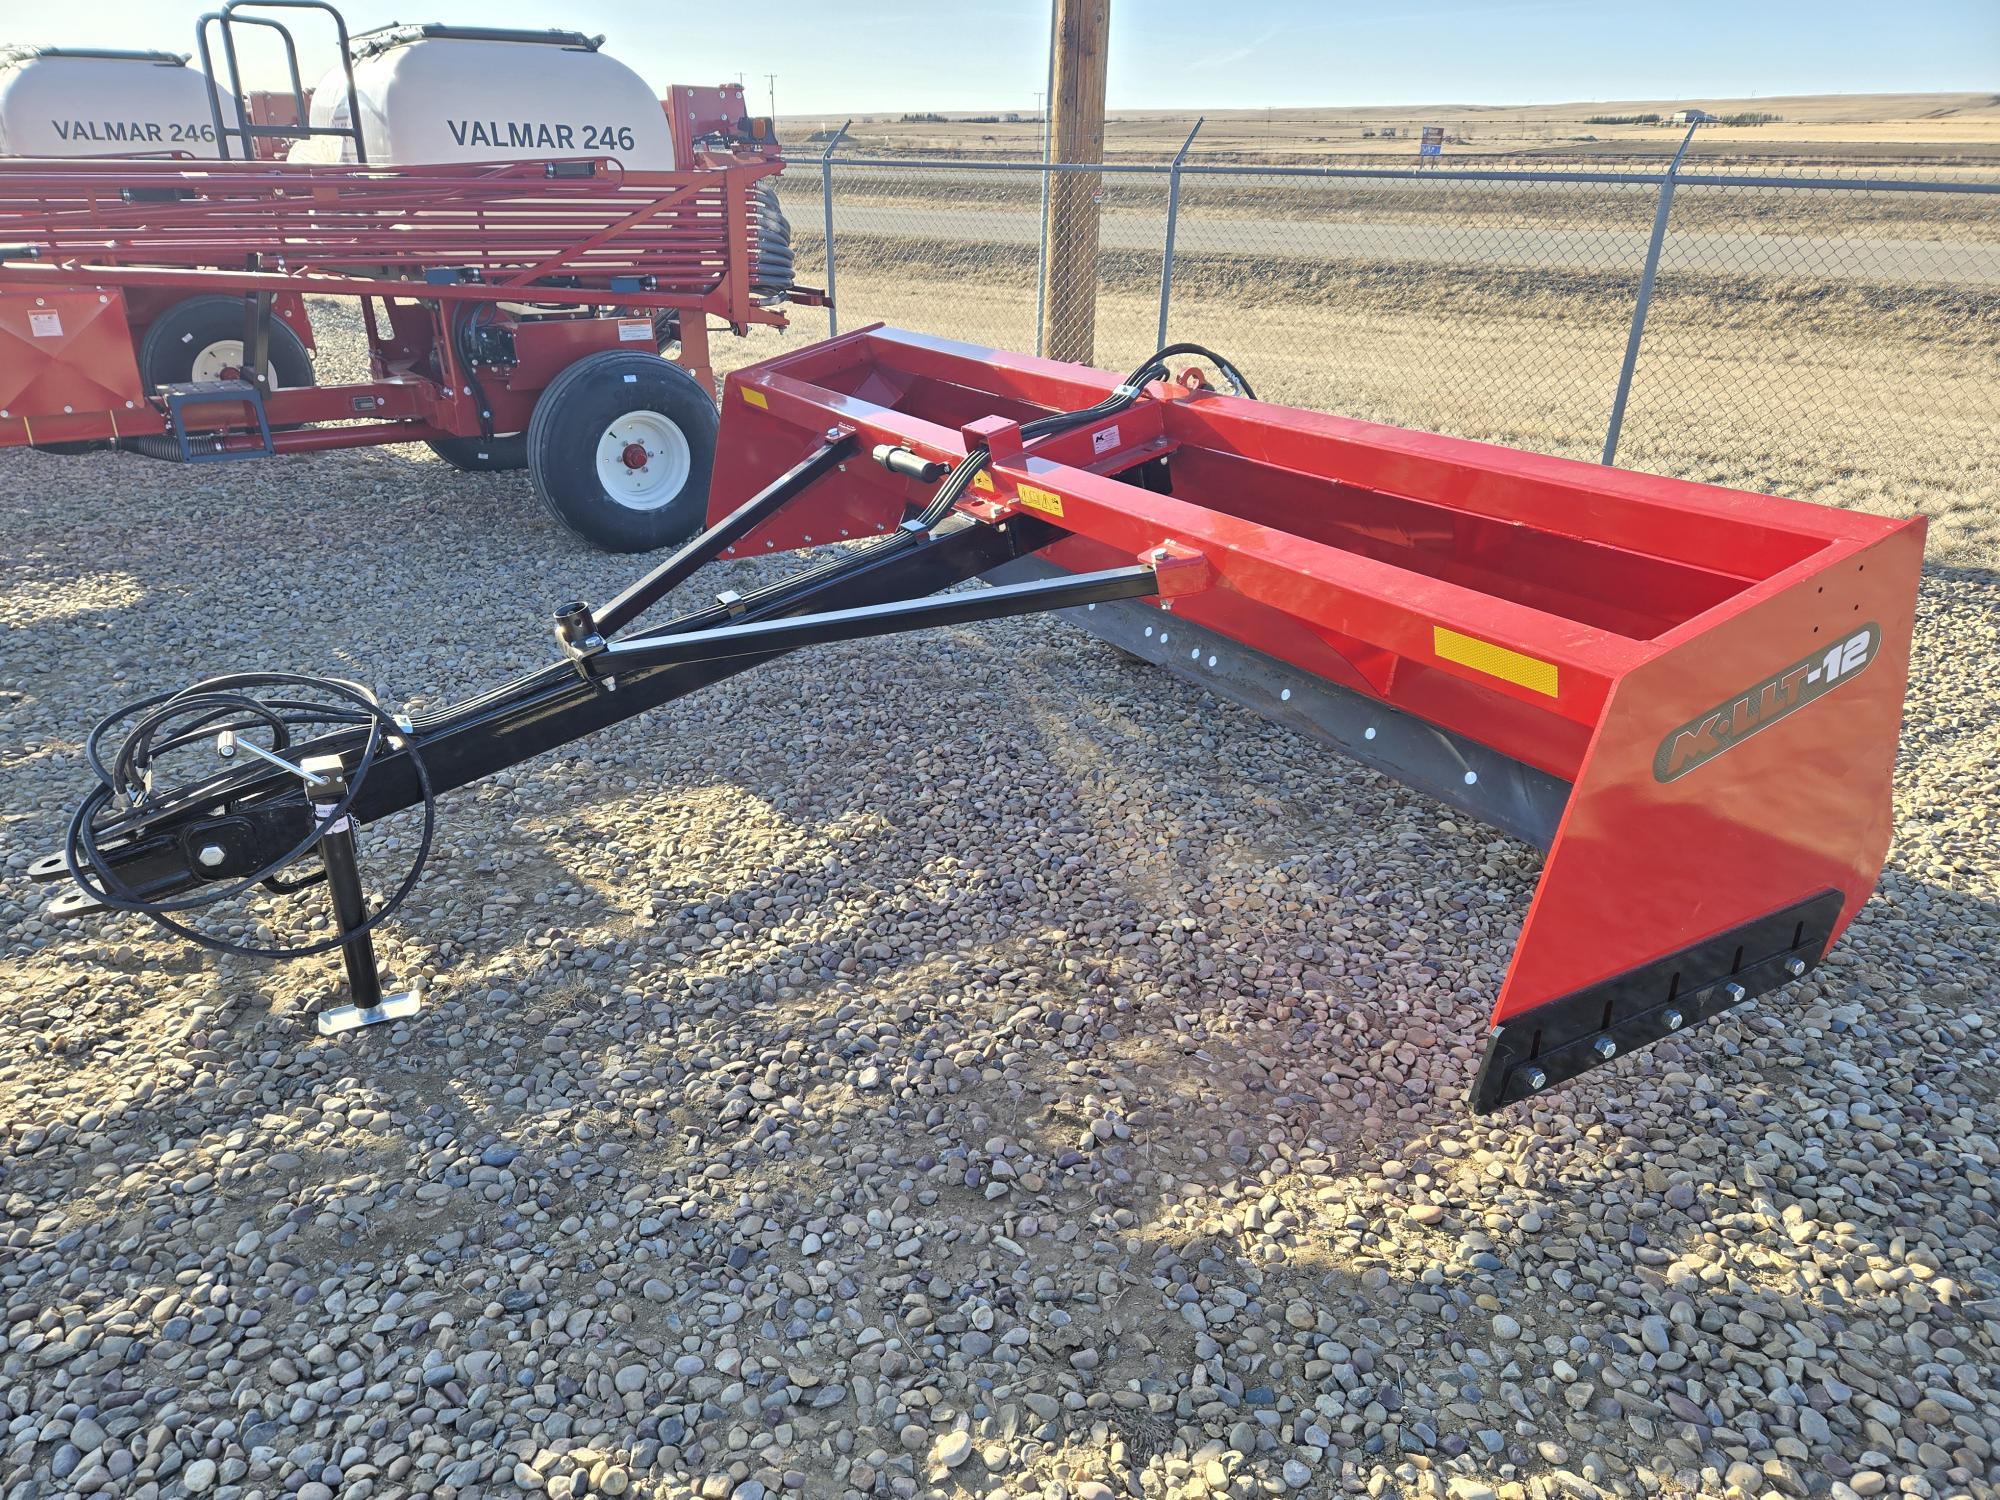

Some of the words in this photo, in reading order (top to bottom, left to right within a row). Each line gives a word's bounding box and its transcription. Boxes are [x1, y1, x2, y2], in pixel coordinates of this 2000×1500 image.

[52, 120, 163, 142] VALMAR
[169, 123, 216, 143] 246
[446, 120, 575, 149] VALMAR
[582, 125, 635, 151] 246
